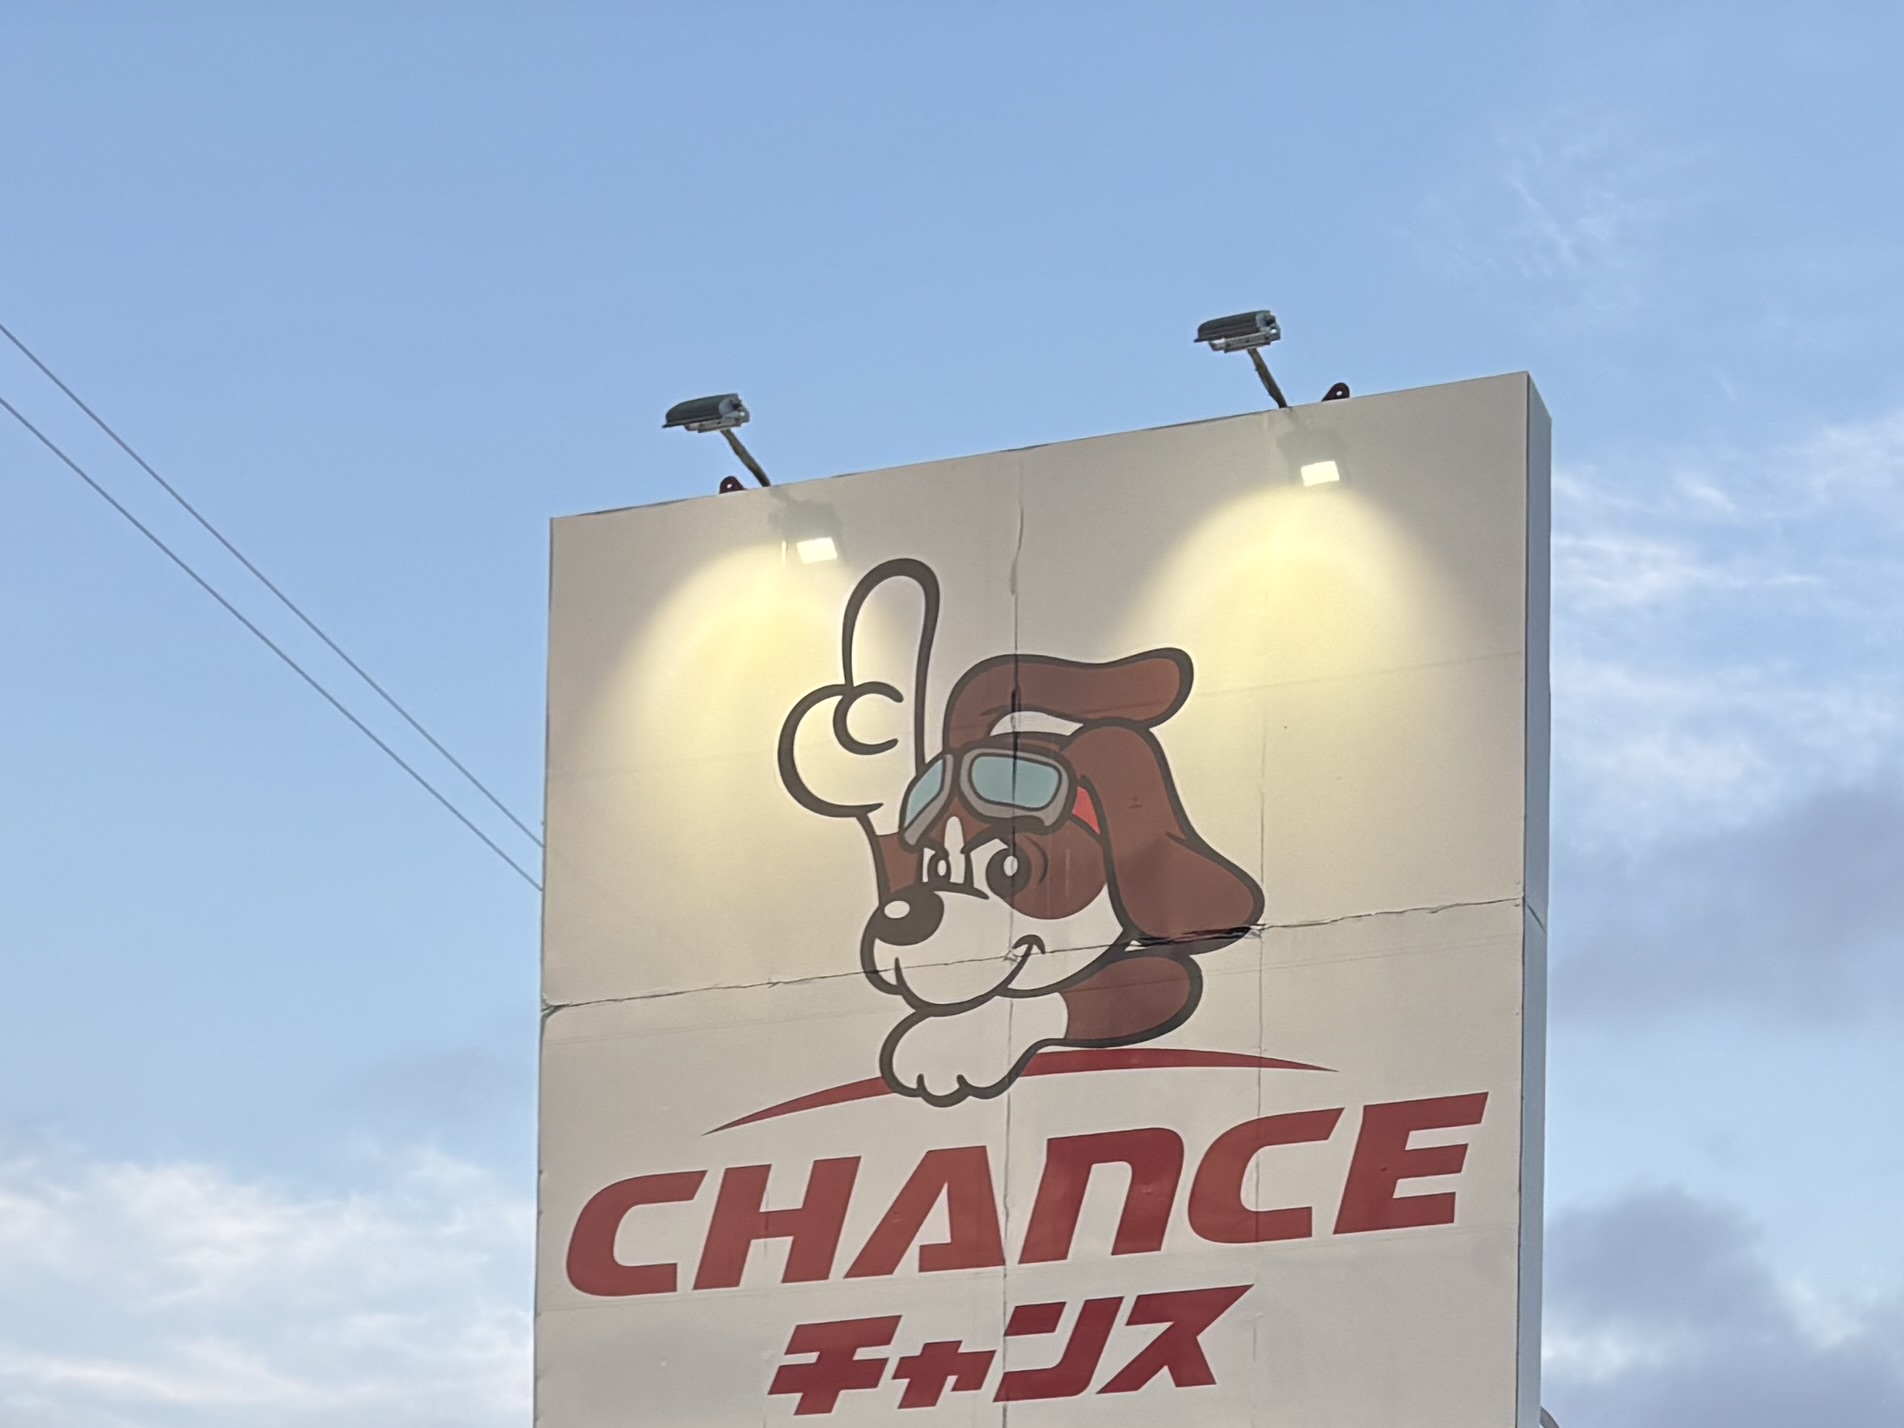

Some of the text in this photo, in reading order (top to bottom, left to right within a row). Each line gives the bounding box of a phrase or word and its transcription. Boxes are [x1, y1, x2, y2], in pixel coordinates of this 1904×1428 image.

[565, 1092, 1489, 1297] CHANCE
[767, 1283, 1255, 1415] チャンス
